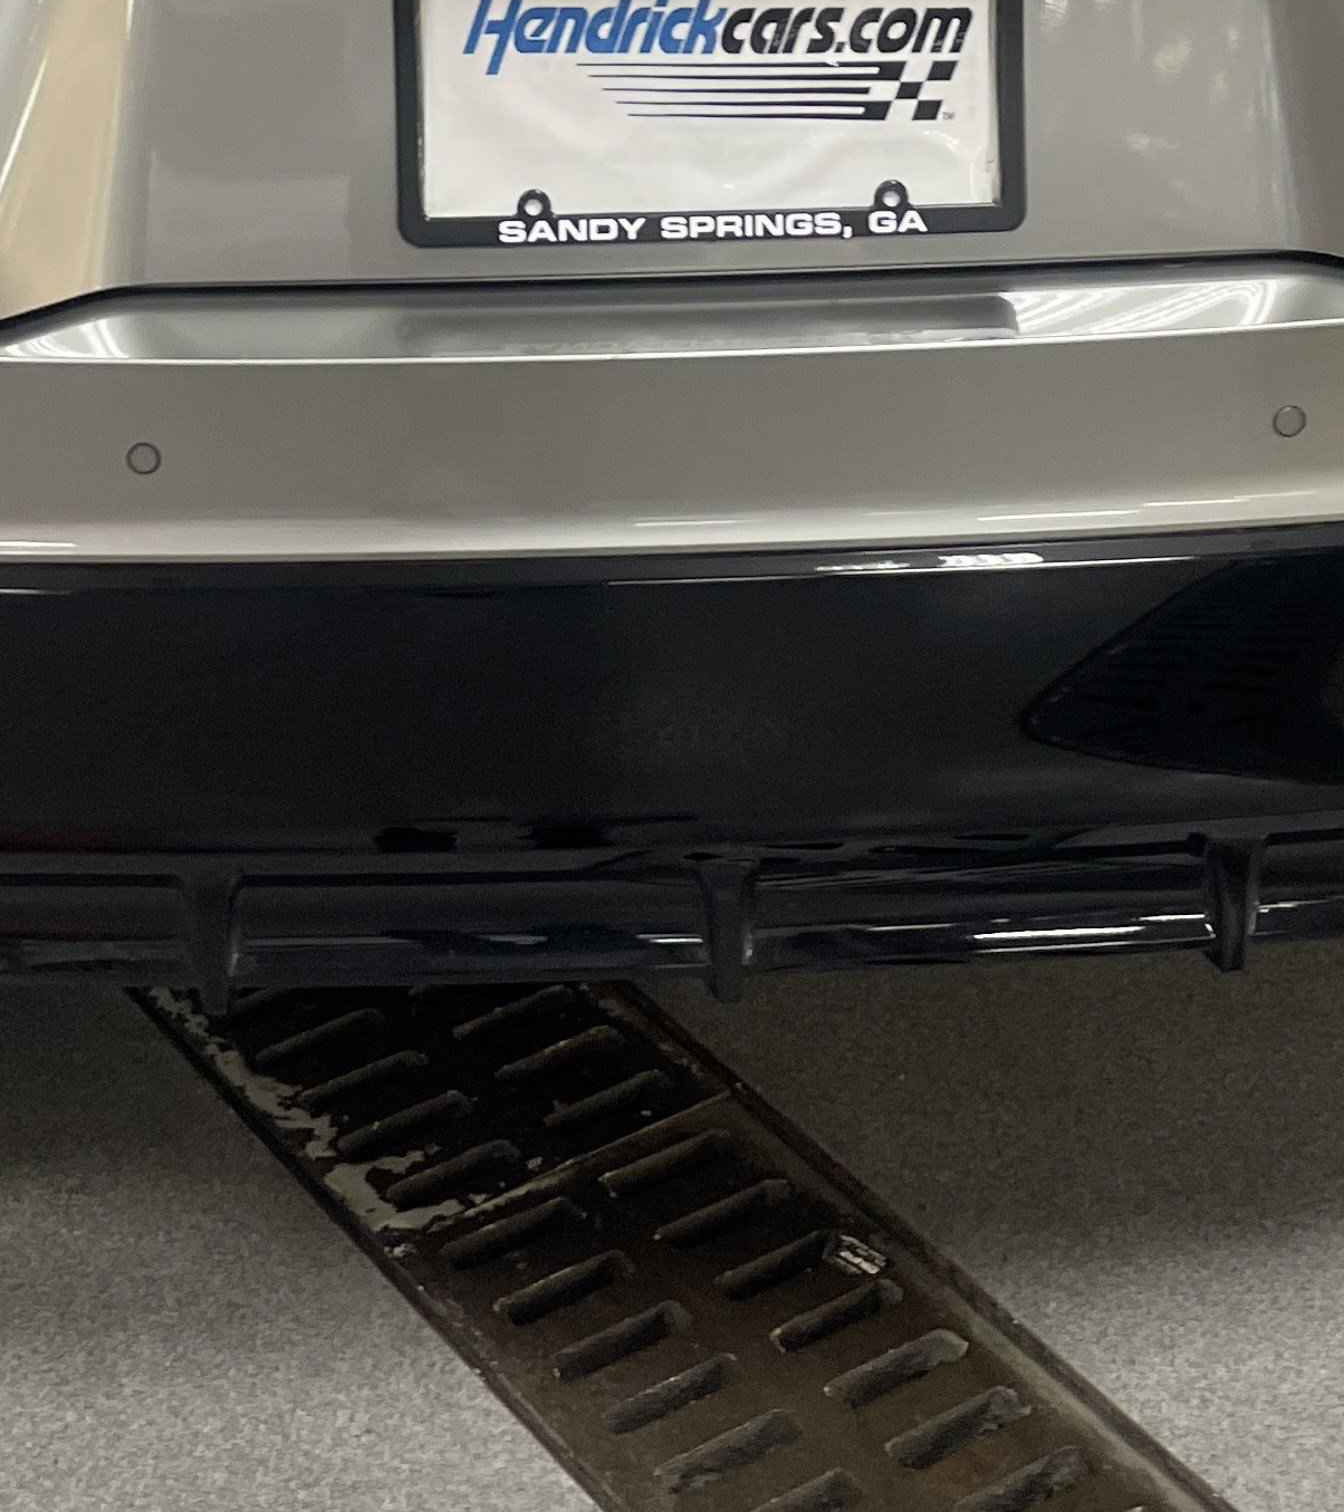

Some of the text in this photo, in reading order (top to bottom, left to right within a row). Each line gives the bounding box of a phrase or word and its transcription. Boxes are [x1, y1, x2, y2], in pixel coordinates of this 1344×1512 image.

[498, 210, 928, 244] SANDY SPRINGS, GA
